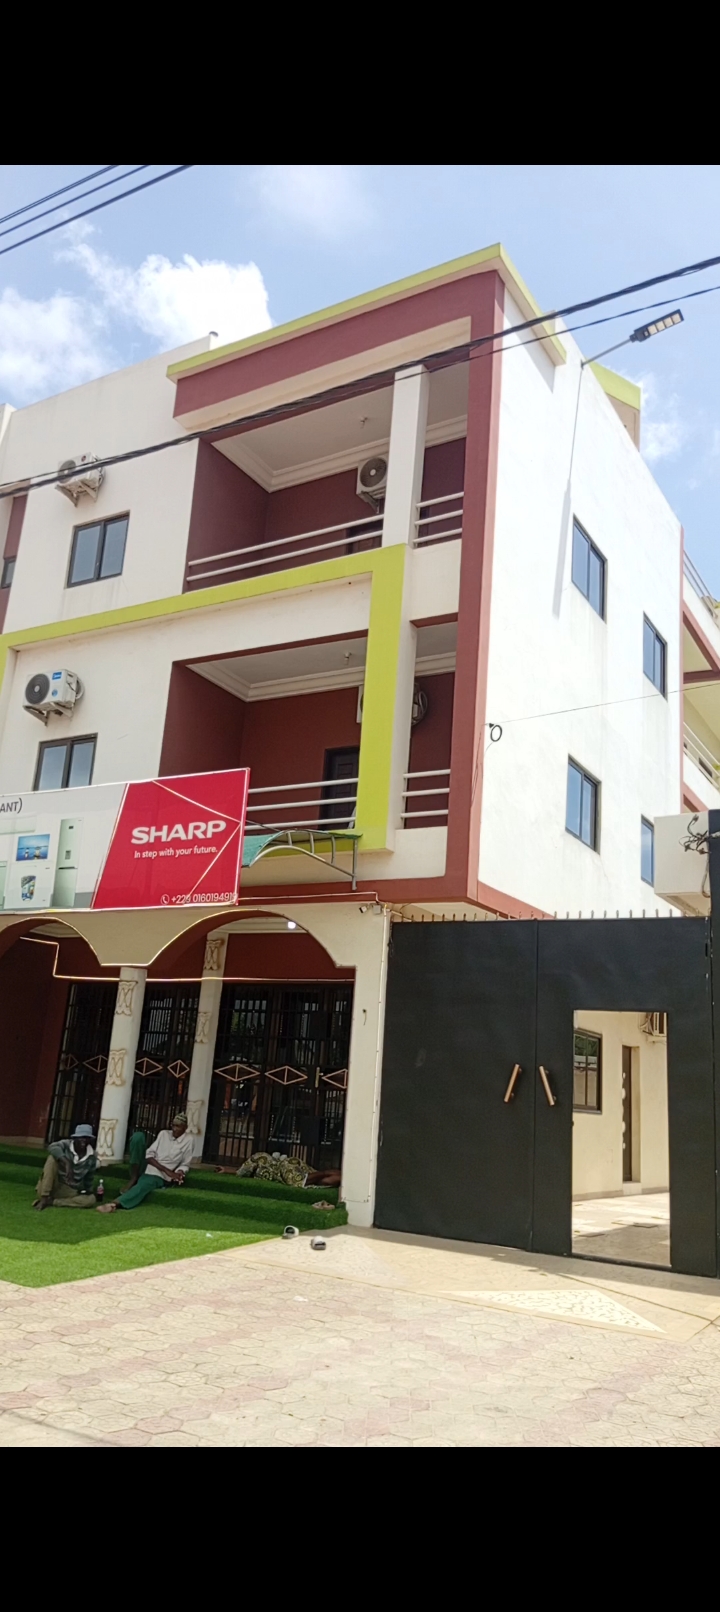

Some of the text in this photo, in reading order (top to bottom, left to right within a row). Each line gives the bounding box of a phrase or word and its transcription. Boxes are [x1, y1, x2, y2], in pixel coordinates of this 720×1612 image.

[130, 819, 227, 845] SHARP
[134, 845, 218, 860] In step with your future.
